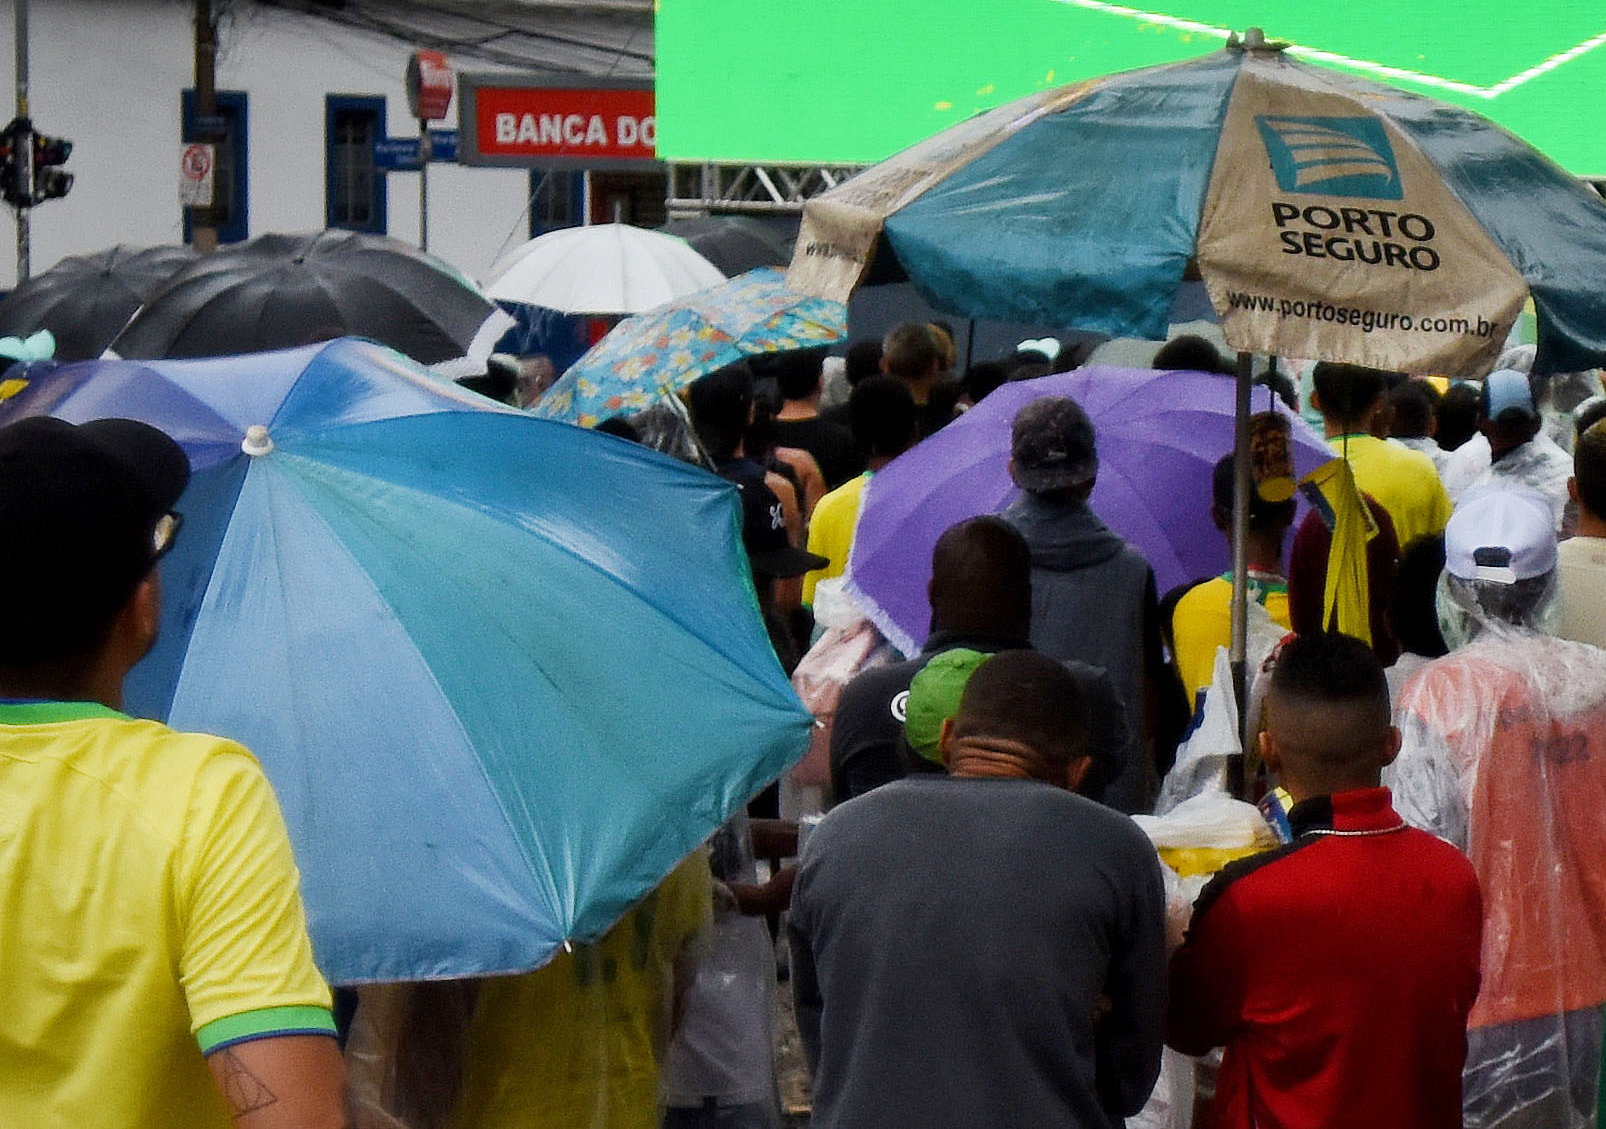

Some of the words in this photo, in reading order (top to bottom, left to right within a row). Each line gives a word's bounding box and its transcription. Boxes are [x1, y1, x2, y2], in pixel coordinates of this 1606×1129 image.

[495, 112, 607, 145] BANCA
[1272, 202, 1435, 242] PORTO
[1279, 230, 1440, 271] SEGURO
[1226, 289, 1498, 339] www.portoseguro.com.br
